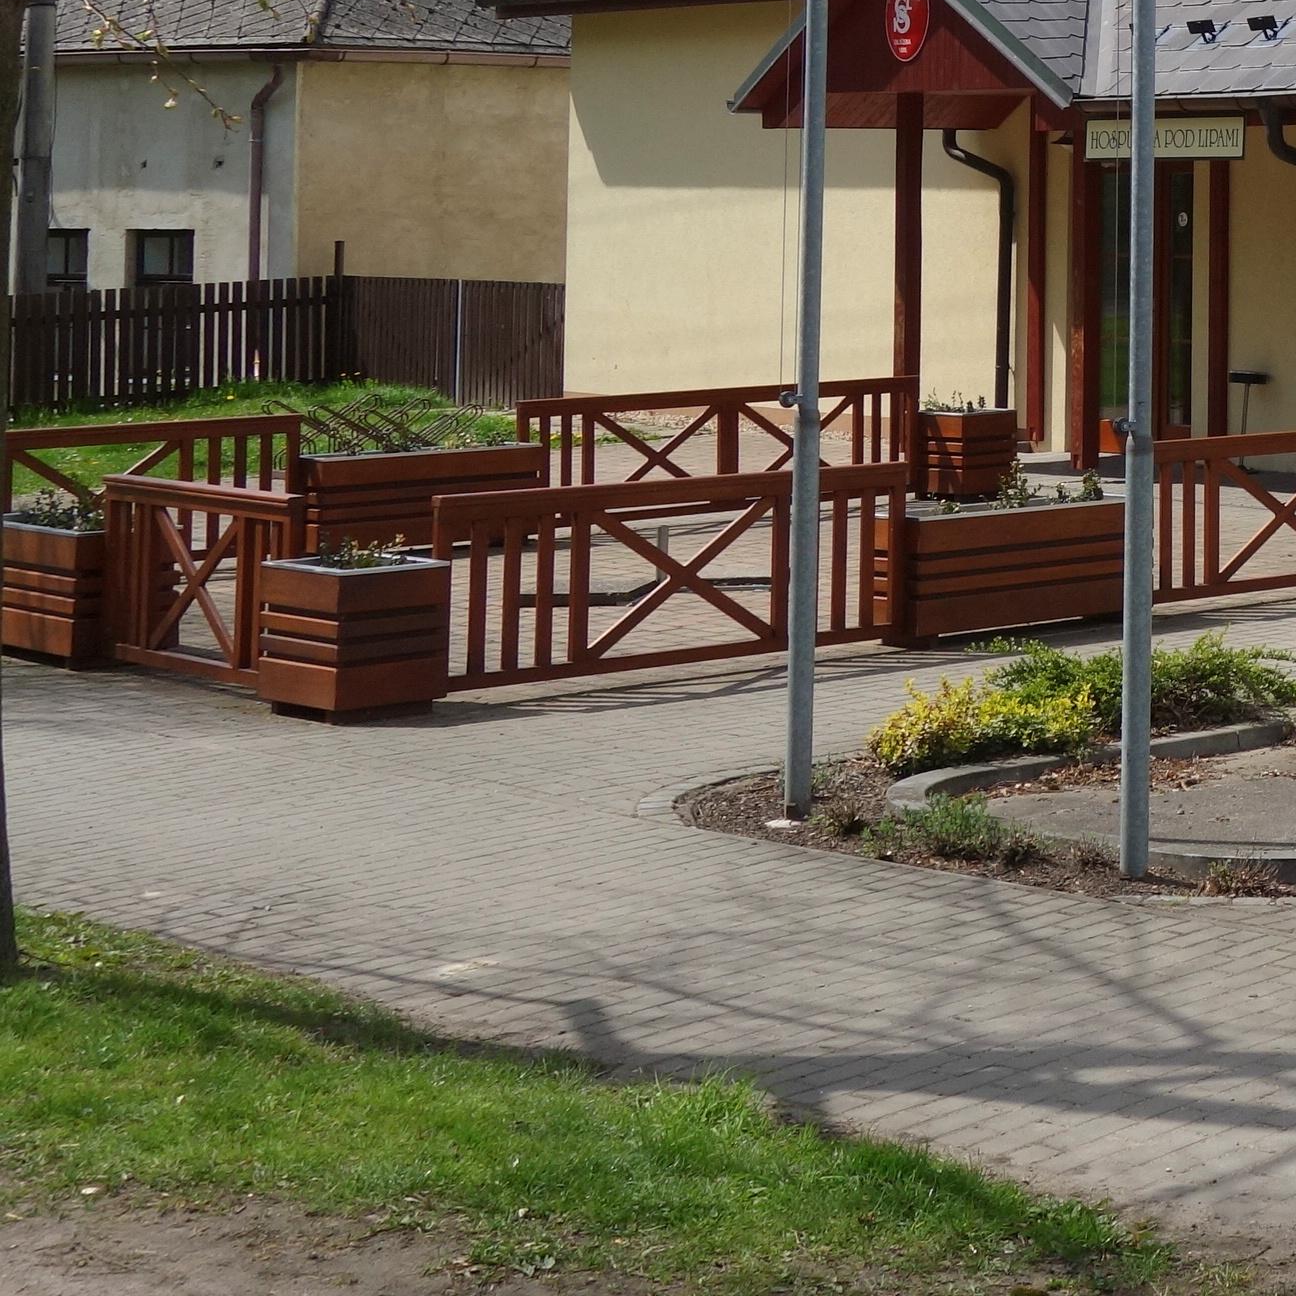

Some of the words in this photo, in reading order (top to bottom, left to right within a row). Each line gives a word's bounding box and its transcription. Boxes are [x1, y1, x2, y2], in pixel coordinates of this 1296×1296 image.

[1090, 129, 1161, 150] HOSPA
[1164, 128, 1195, 149] POD
[1198, 128, 1240, 148] LIPAMI
